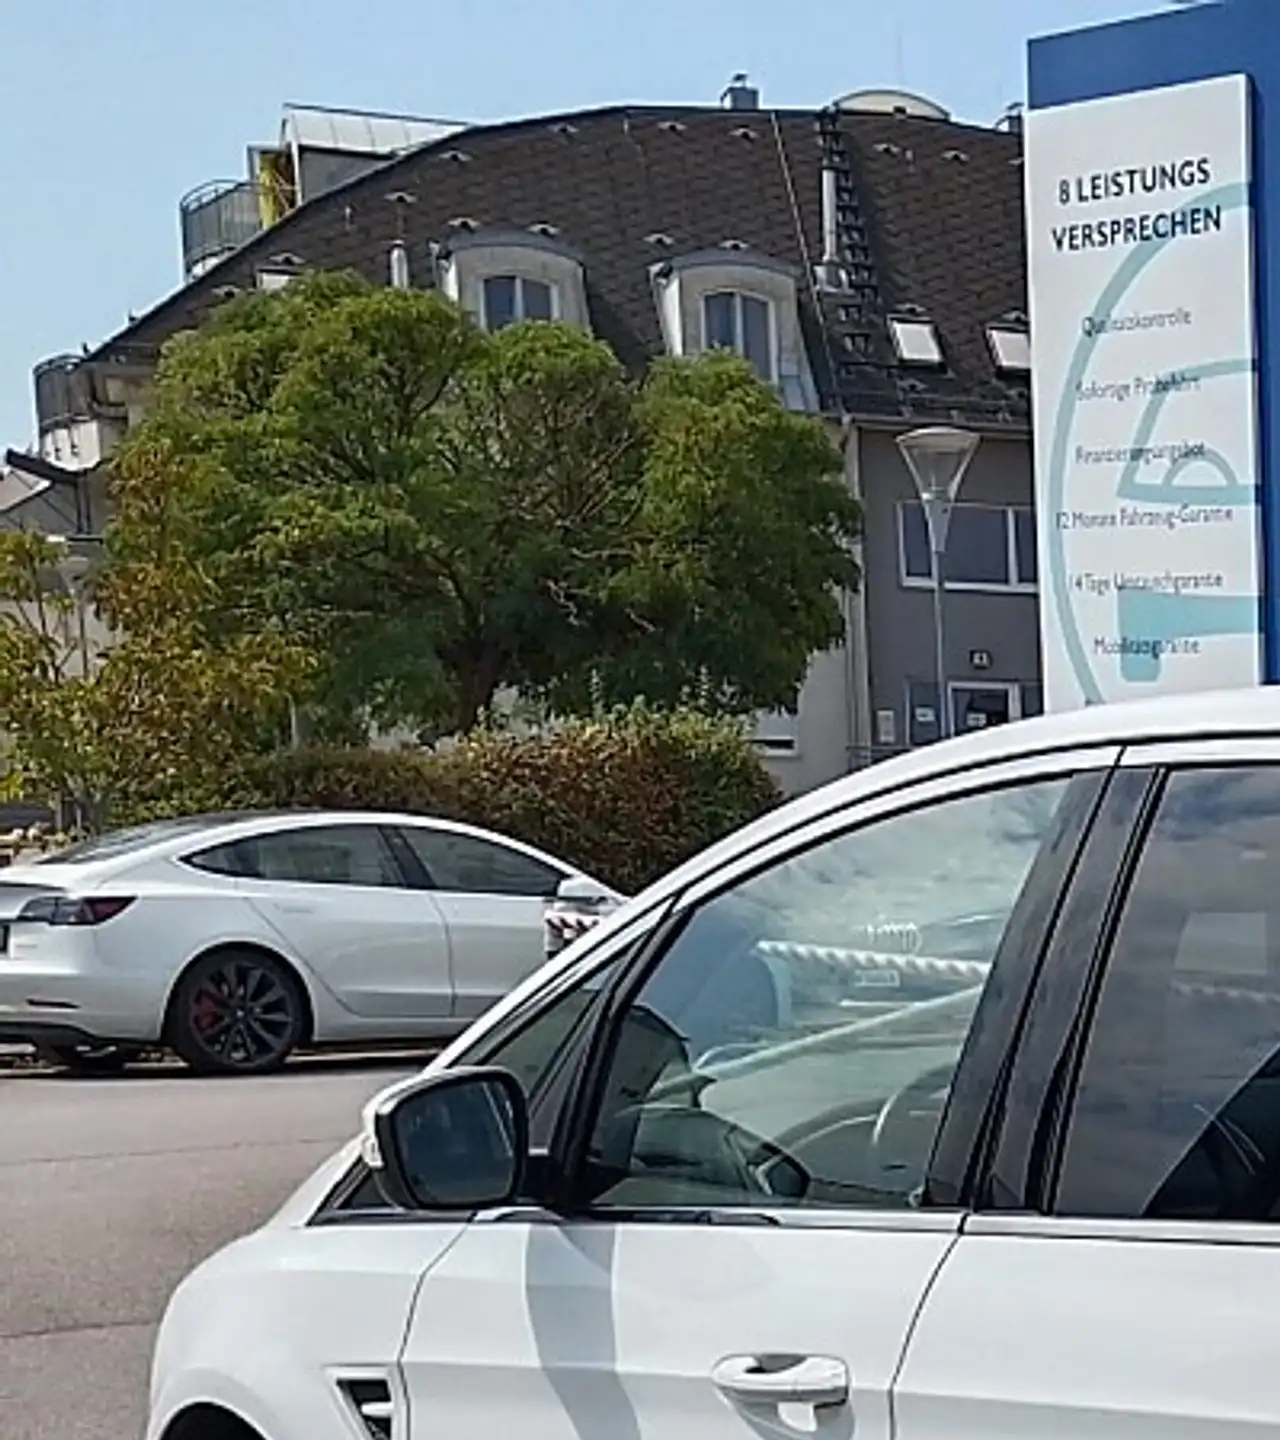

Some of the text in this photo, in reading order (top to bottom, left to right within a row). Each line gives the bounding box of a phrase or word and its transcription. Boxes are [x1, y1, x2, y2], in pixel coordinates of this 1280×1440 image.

[1059, 158, 1210, 204] 8 LEISTUNGS
[1051, 205, 1221, 251] VERSPRECHEN
